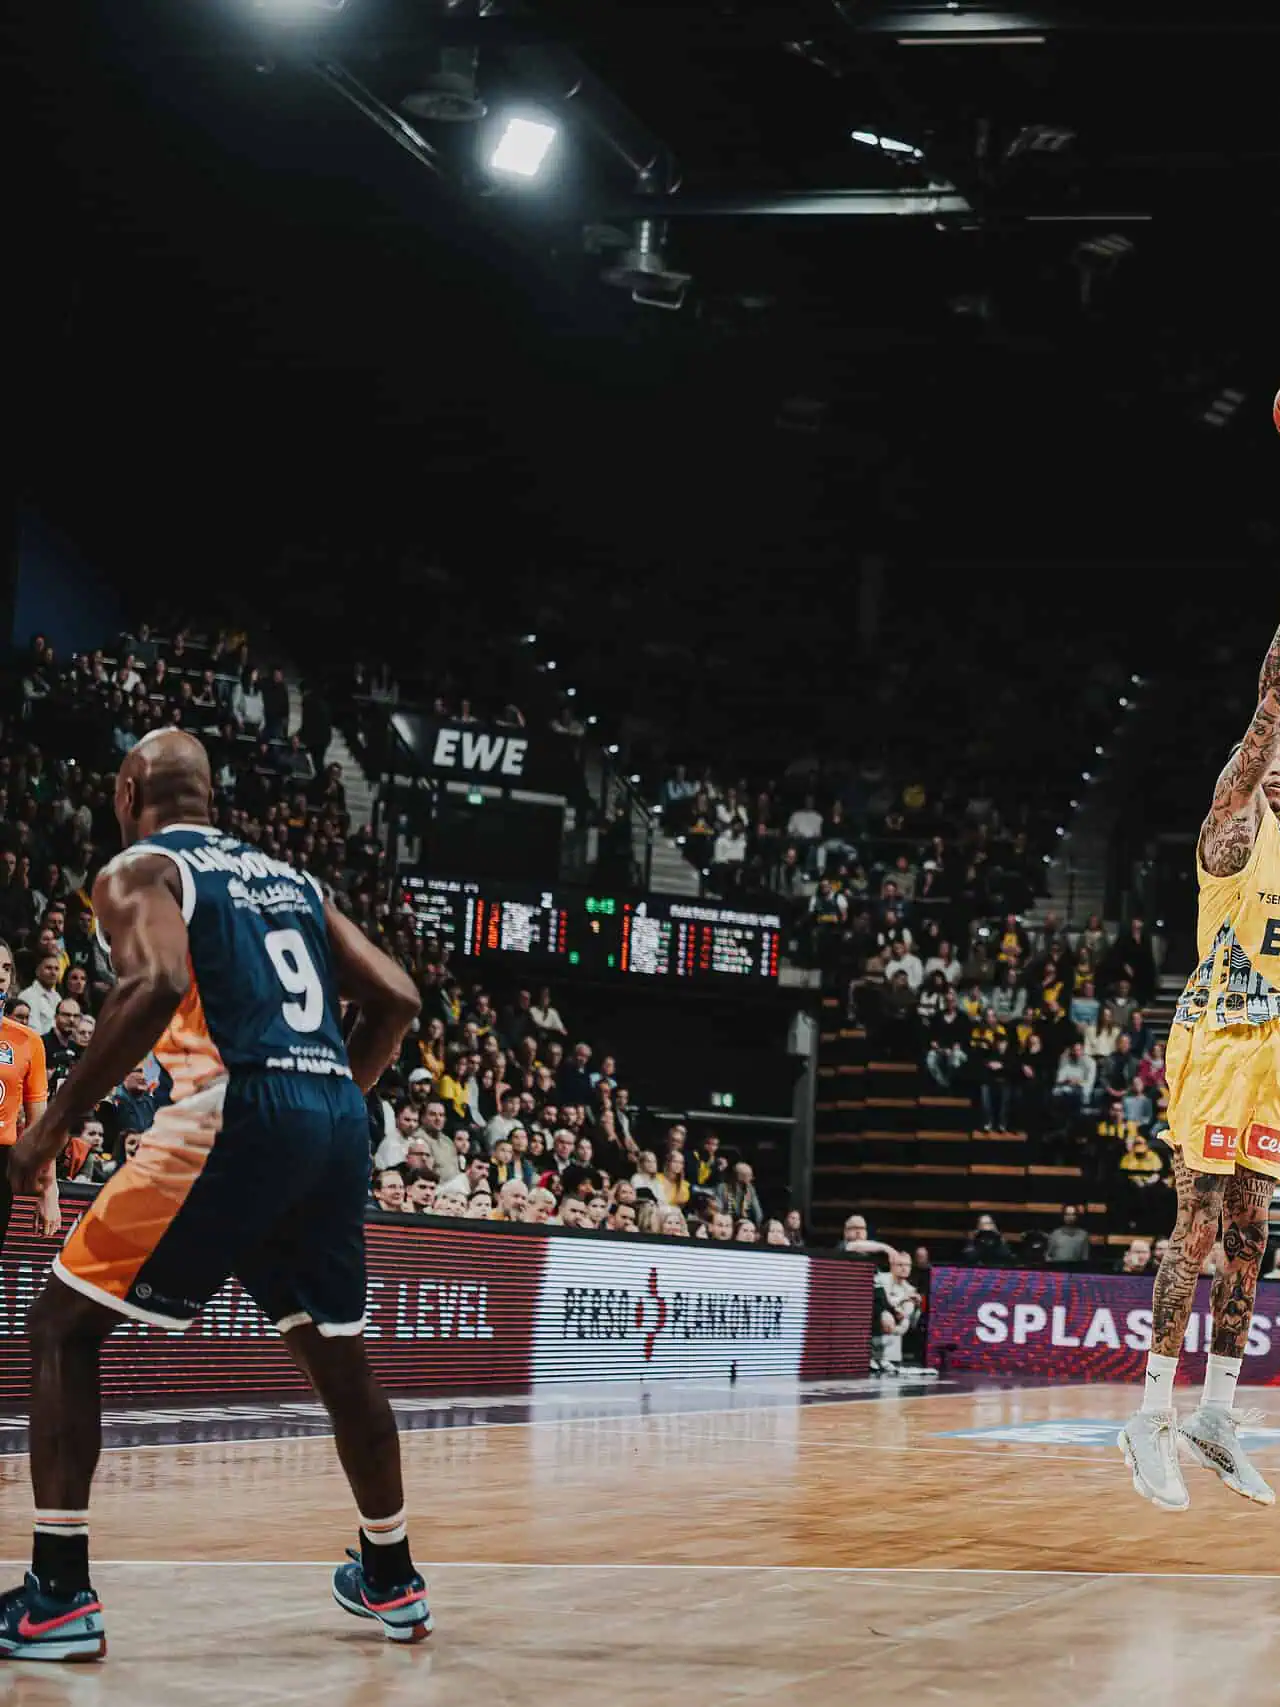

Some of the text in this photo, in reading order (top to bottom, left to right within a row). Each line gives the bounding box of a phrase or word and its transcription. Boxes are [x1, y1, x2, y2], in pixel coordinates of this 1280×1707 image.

[433, 728, 528, 776] EWE
[264, 929, 324, 1033] 9
[396, 1277, 494, 1338] LEVEL
[563, 1286, 630, 1341] PERSO
